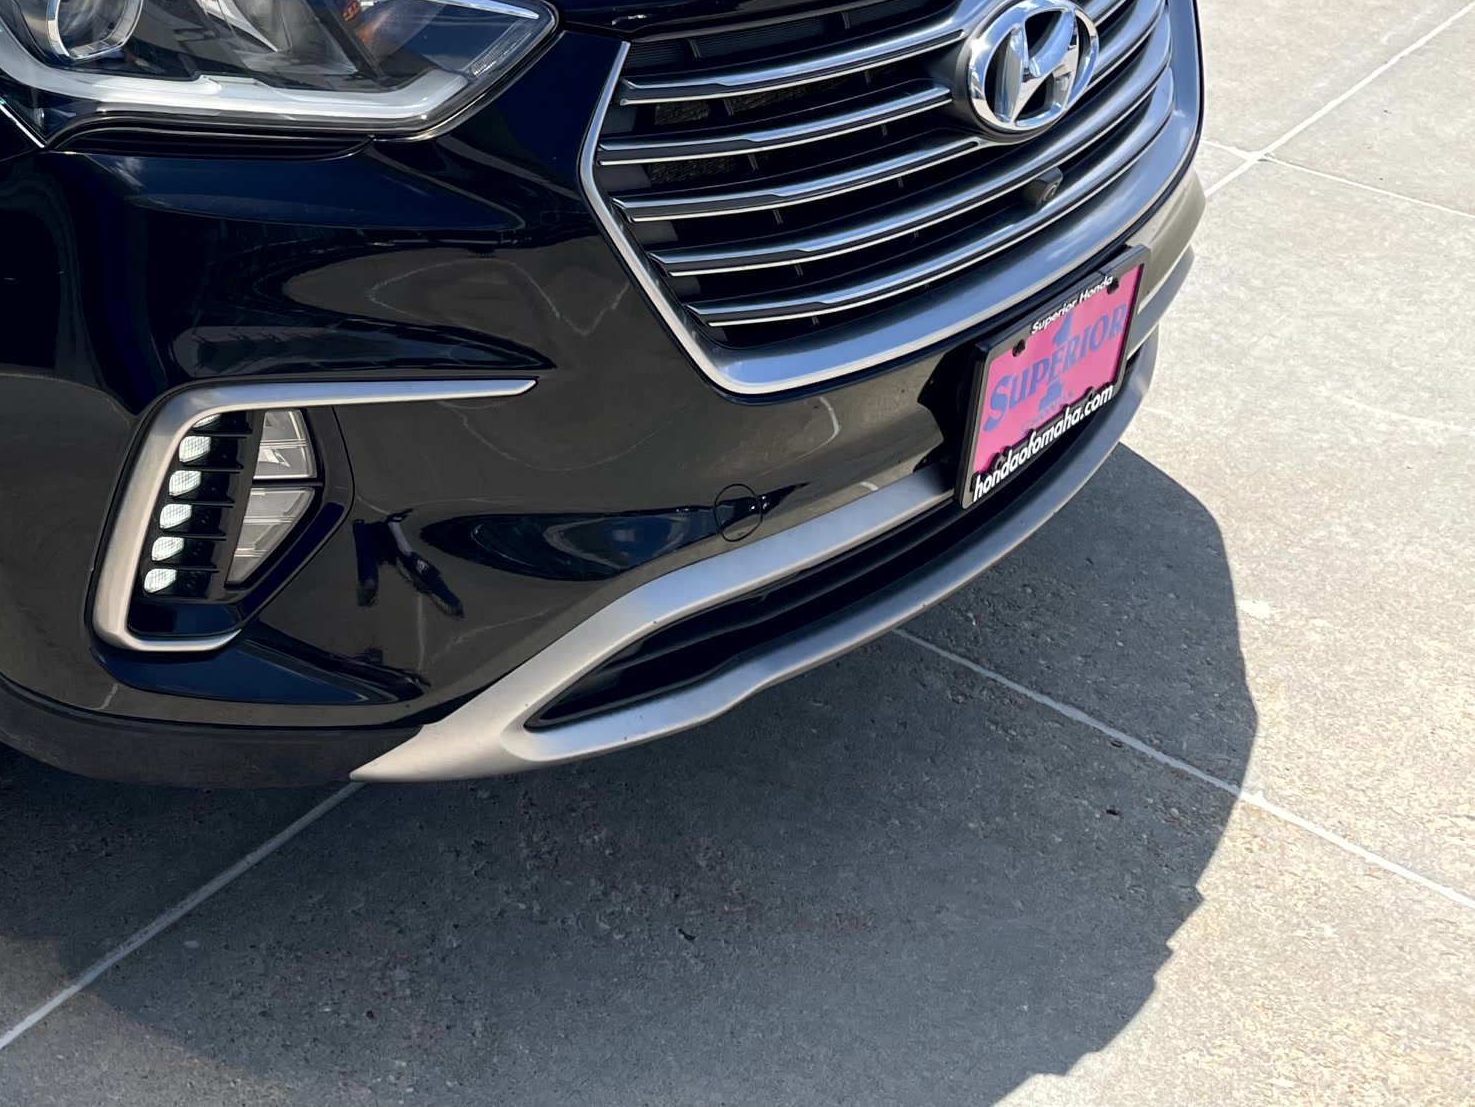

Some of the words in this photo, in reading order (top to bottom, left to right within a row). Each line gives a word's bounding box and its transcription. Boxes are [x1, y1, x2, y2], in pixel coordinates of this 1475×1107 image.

[1030, 299, 1078, 335] Superior
[1078, 275, 1114, 304] Honda
[983, 302, 1128, 433] SUPERIOR
[973, 384, 1114, 503] hondaofomaha.com
